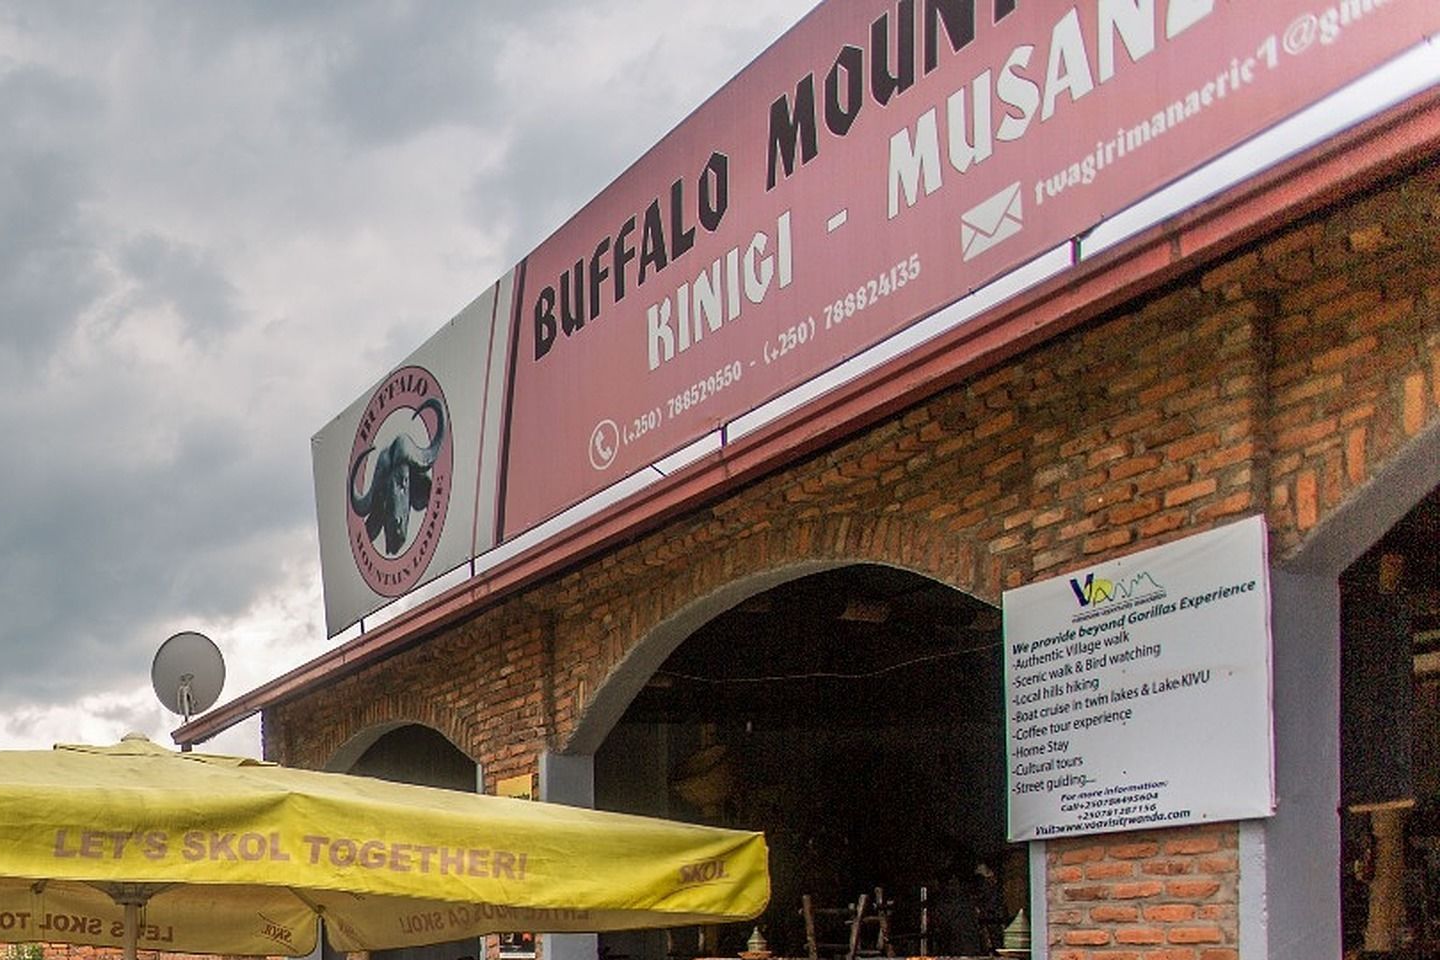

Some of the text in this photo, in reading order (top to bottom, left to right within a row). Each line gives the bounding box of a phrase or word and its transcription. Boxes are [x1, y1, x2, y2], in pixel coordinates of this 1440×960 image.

[535, 0, 1020, 361] BUFFALO MOUN
[647, 210, 793, 371] KINIGI
[622, 406, 662, 446] (+250)
[667, 361, 743, 418] 788529550
[763, 317, 816, 364] (+250)
[823, 253, 921, 330] 788824135
[1013, 643, 1030, 655] We
[1031, 630, 1076, 653] provide
[1079, 614, 1126, 638] beyond
[1128, 602, 1176, 624] Gorillas
[1180, 579, 1256, 610] Experience
[1066, 639, 1101, 655] Village
[1104, 631, 1130, 647] walk
[1049, 664, 1073, 680] walk
[1075, 661, 1084, 673] &
[1086, 654, 1107, 671] Bird
[1109, 642, 1161, 664] watching
[1040, 703, 1071, 718] cruise
[1072, 699, 1083, 712] in
[1085, 694, 1109, 710] twin
[1110, 687, 1139, 703] lakes
[1141, 684, 1150, 696] &
[1152, 679, 1180, 695] Lake
[1181, 669, 1211, 688] KIVU
[1043, 684, 1064, 699] hills
[1066, 678, 1100, 694] hiking
[1050, 720, 1072, 735] tour
[1073, 708, 1132, 730] experience
[1047, 739, 1069, 756] Stay
[1056, 755, 1083, 769] tours
[1078, 789, 1103, 800] more
[53, 829, 527, 881] LET'S SKOL TOGETHER!
[679, 860, 729, 884] SKOL
